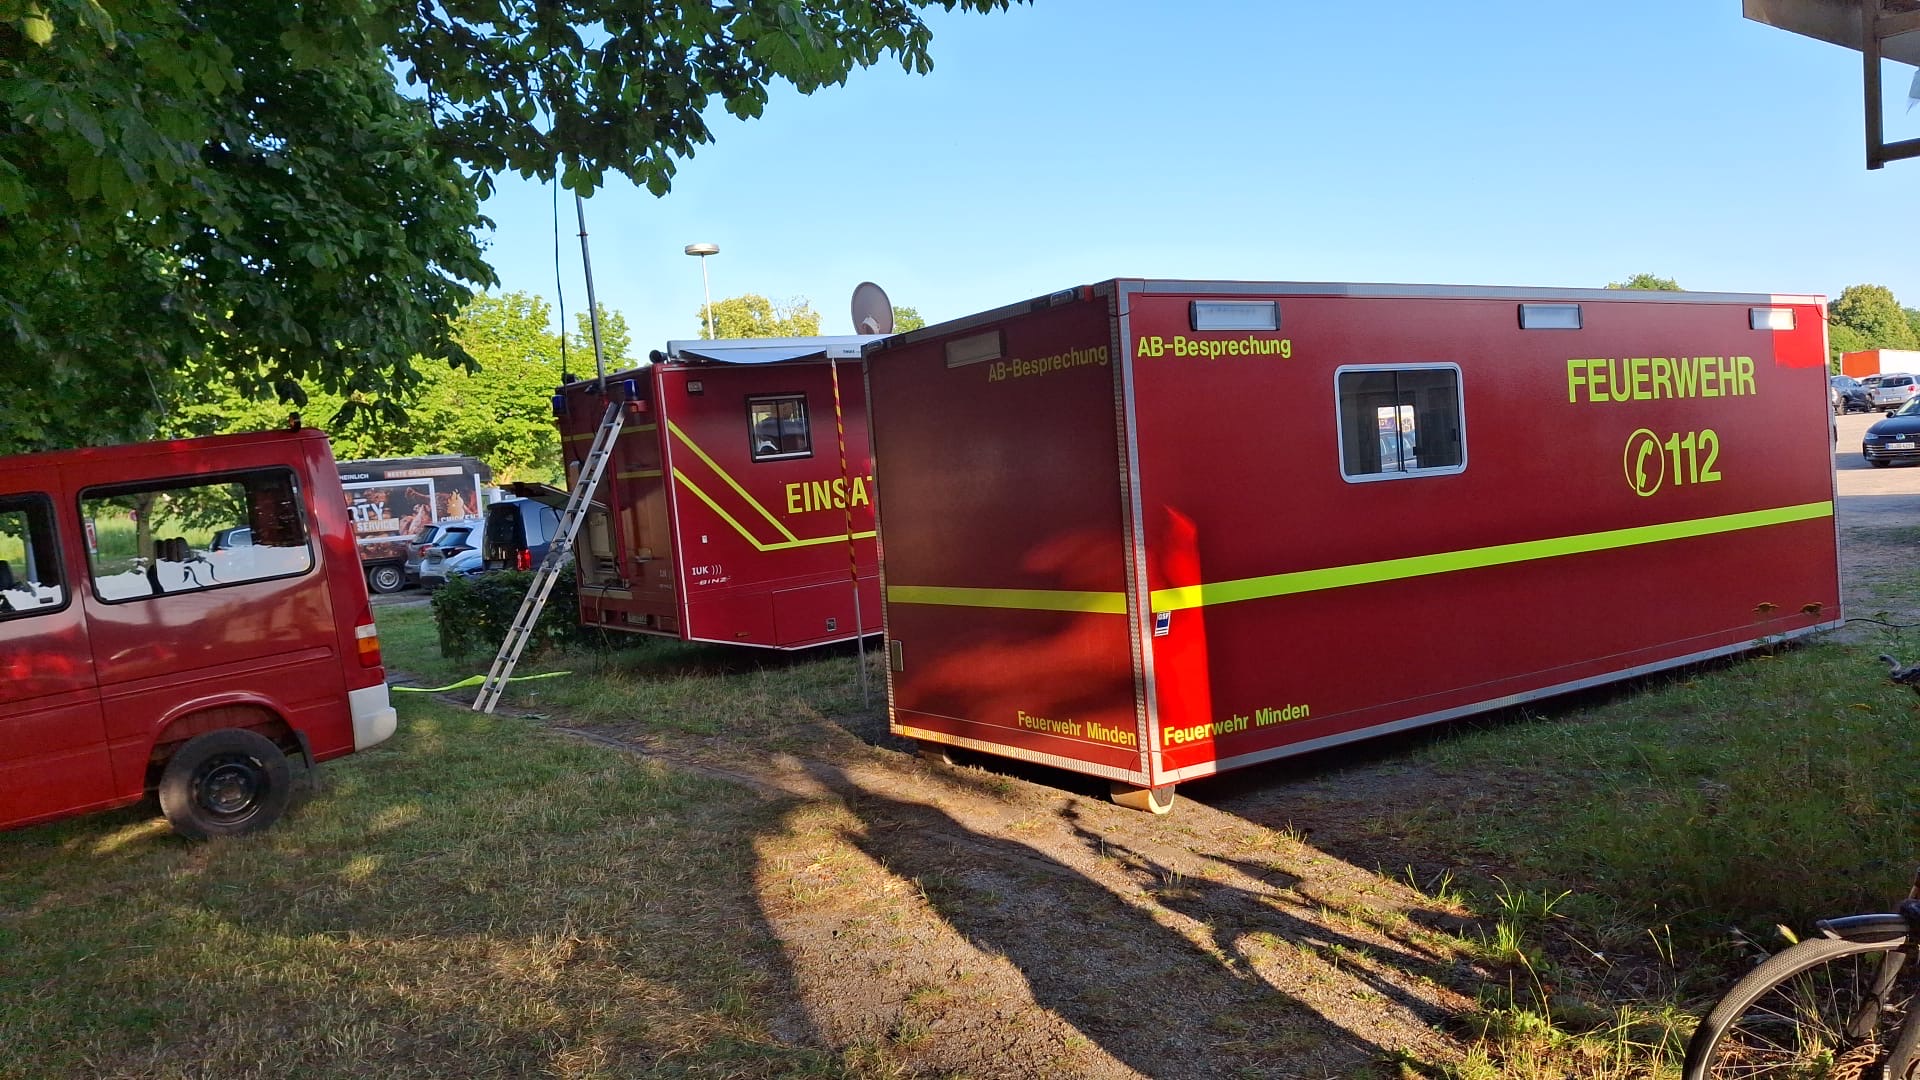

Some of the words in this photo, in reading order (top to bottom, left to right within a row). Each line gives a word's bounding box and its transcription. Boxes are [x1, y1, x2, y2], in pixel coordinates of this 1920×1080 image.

[988, 345, 1107, 382] AB-Besprechung
[1137, 335, 1291, 360] AB-Besprechung
[1567, 356, 1756, 403] FEUERWEHR
[1665, 429, 1721, 485] 112
[786, 476, 872, 513] EINSA
[691, 566, 709, 576] IUK
[1017, 710, 1082, 736] Feuerwehr
[1086, 721, 1137, 746] Minden
[1163, 714, 1249, 746] Feuerwehr
[1255, 704, 1310, 727] Minden
